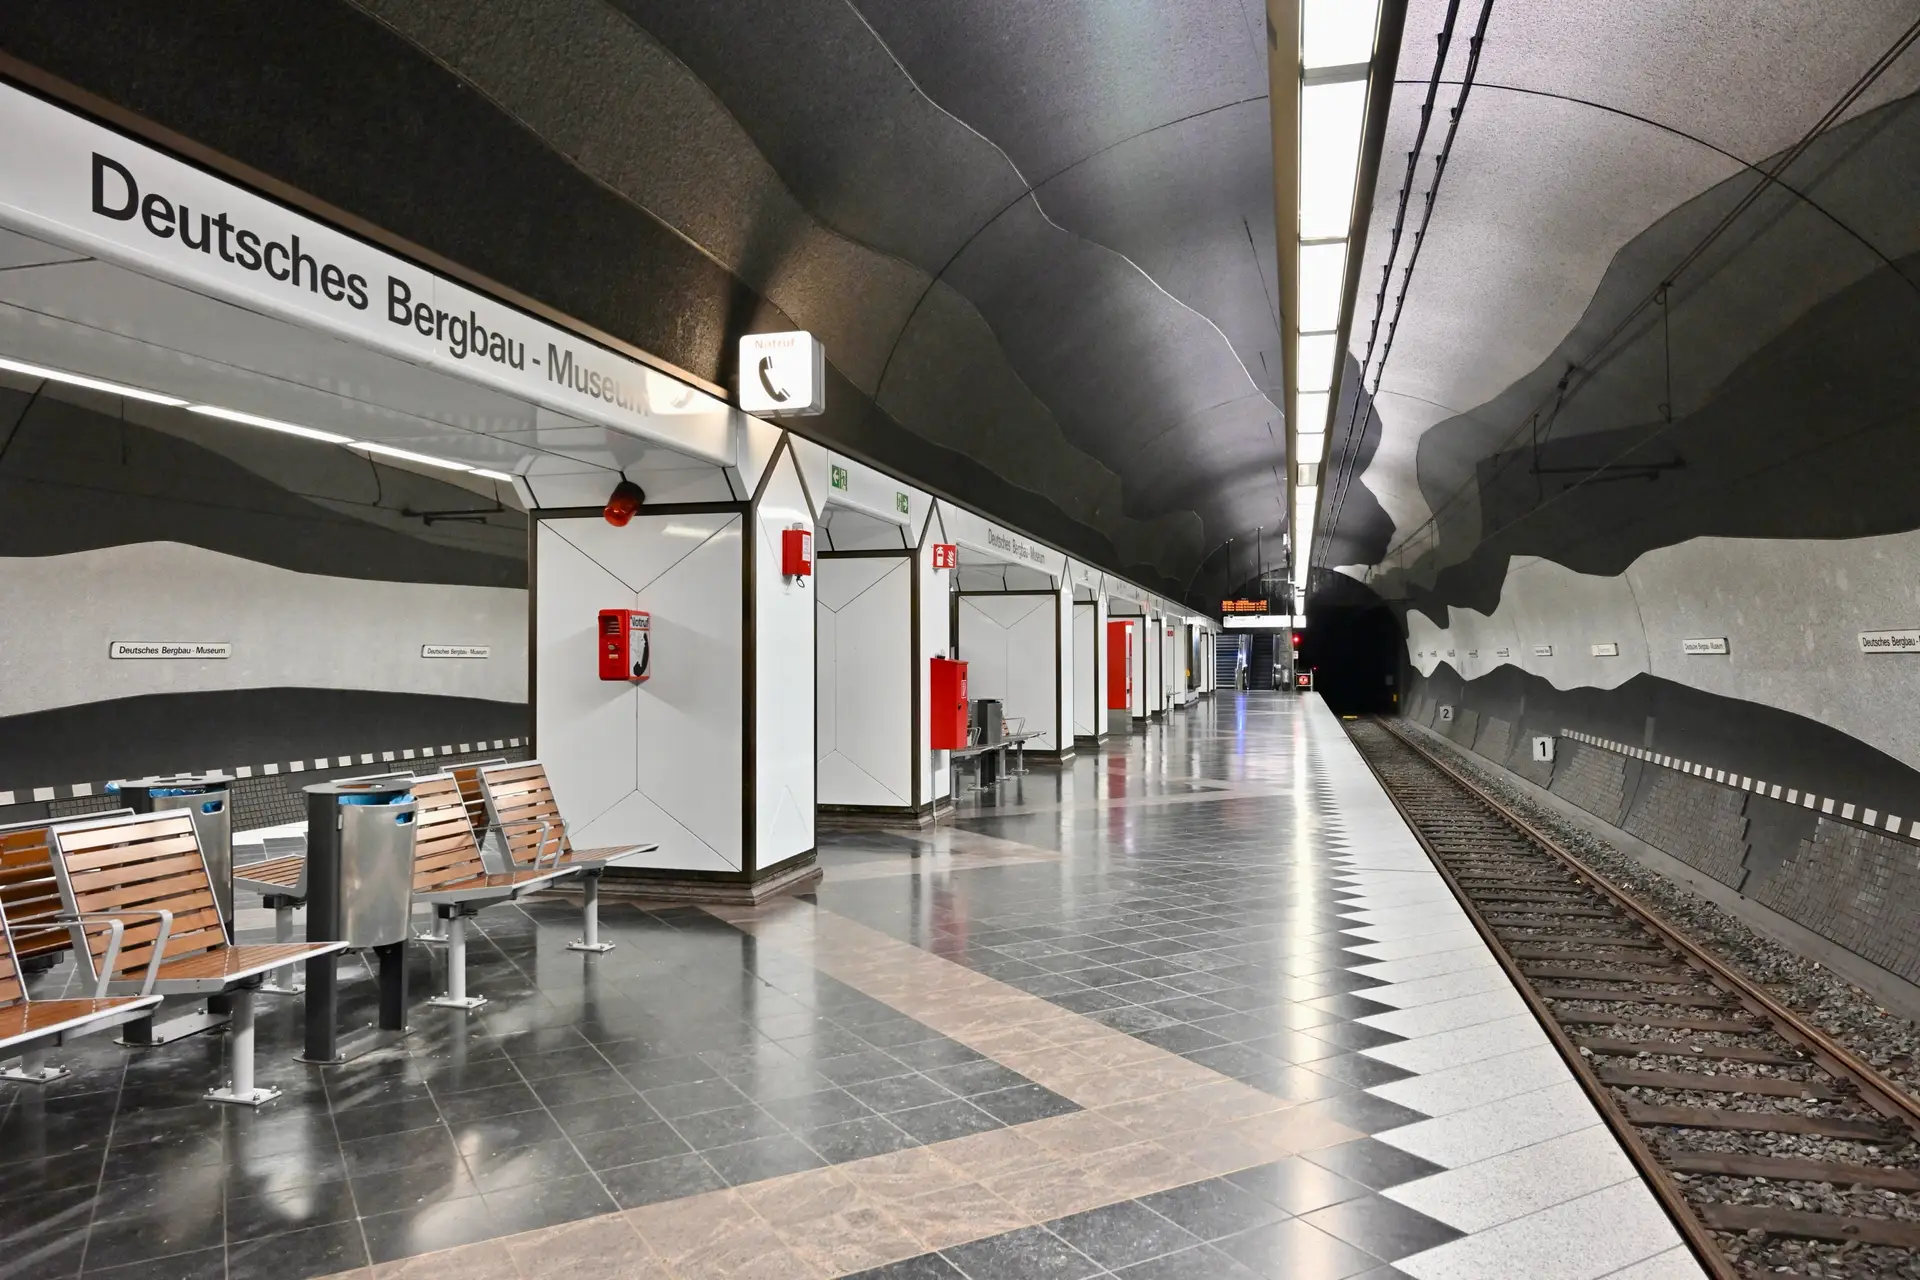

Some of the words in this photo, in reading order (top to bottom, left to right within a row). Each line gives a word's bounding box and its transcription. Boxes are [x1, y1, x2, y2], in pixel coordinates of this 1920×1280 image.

[92, 151, 369, 311] Deutsches
[387, 275, 525, 371] Bergbau
[987, 528, 1011, 552] Deutsches
[1862, 636, 1891, 647] Deutsches
[1891, 635, 1916, 649] Bergbau
[119, 646, 159, 654] Deutsches
[161, 646, 192, 656] Bergbau
[195, 646, 226, 654] Museum
[1443, 708, 1450, 719] 2
[1539, 741, 1546, 757] 1
